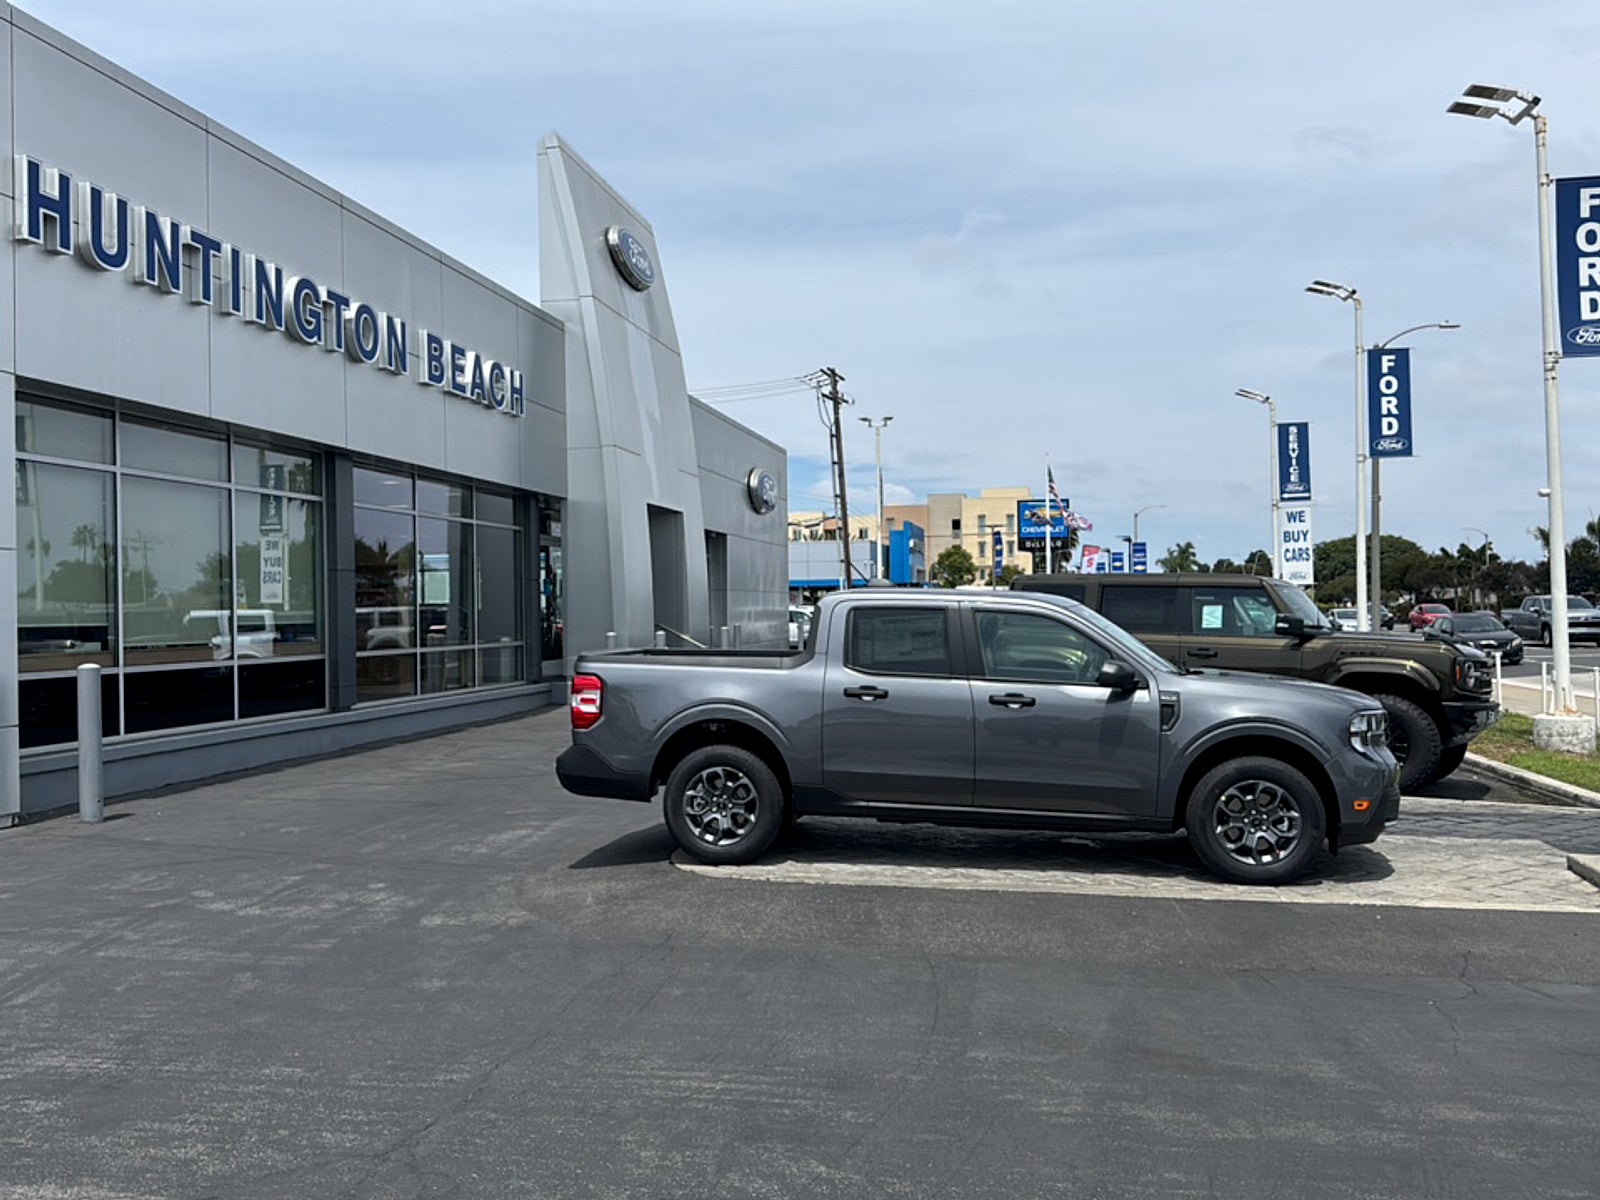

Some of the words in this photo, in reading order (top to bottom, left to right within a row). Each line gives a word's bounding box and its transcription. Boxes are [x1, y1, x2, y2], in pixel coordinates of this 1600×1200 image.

[1575, 187, 1600, 321] FORD
[15, 154, 409, 376] HUNTINGTON
[419, 328, 526, 416] BEACH
[1379, 355, 1399, 436] FORD
[1288, 425, 1300, 483] SERVICE
[1283, 530, 1309, 543] BUY
[1286, 511, 1306, 523] WE
[1283, 548, 1311, 563] CARS
